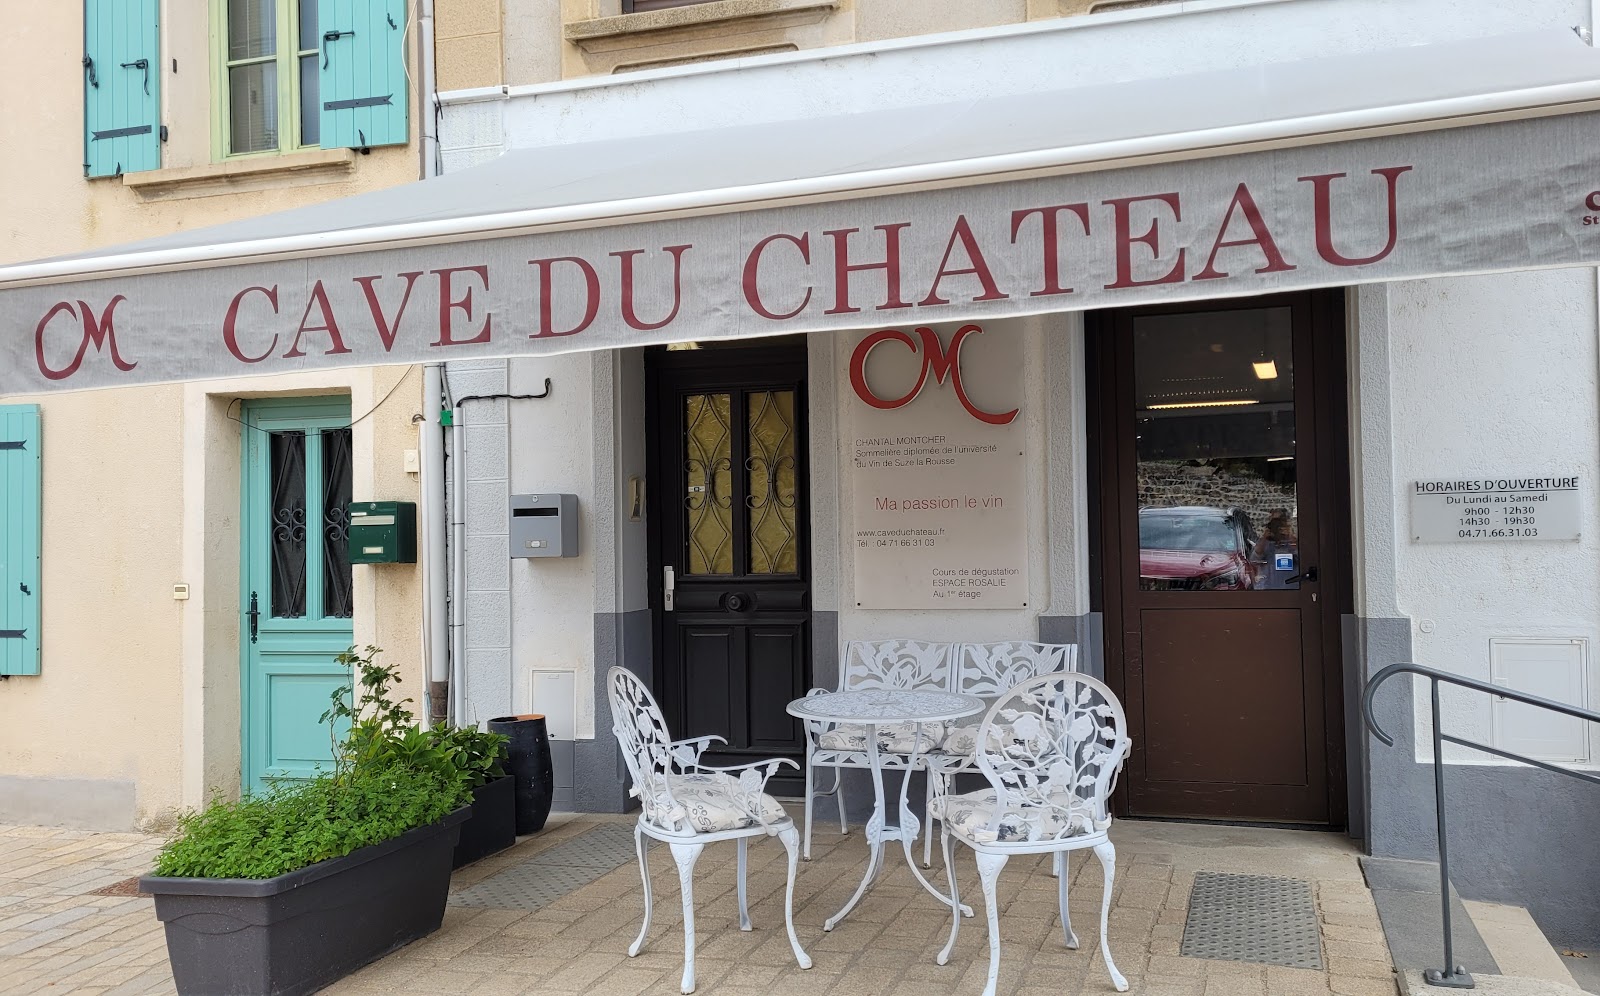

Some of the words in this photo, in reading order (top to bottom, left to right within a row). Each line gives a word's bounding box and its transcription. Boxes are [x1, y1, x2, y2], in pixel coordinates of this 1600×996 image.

[223, 264, 491, 363] CAVE
[529, 244, 693, 339] DU
[742, 165, 1413, 320] CHATEAU
[855, 437, 895, 447] CHANTAL
[896, 435, 946, 445] MONTCHER
[855, 448, 901, 458] Sommelière
[941, 446, 953, 454] de
[954, 444, 997, 454] l'université
[856, 460, 867, 468] du
[868, 459, 881, 468] Vin
[882, 459, 893, 467] de
[894, 458, 915, 467] Suze
[916, 458, 924, 466] la
[925, 457, 956, 466] Rousse
[1416, 480, 1481, 492] HORAIRES
[875, 497, 898, 511] Ma
[902, 495, 959, 514] passion
[964, 494, 977, 509] le
[981, 494, 1003, 508] vin
[1446, 496, 1461, 504] Du
[1463, 494, 1492, 504] Lundi
[1509, 493, 1548, 503] Samedi
[1464, 507, 1490, 516] 9h00
[1502, 506, 1535, 515] 12h30
[1459, 517, 1490, 526] 14h30
[1503, 516, 1536, 525] 19h30
[856, 528, 945, 537] www.caveduchateau.fr
[1458, 528, 1538, 538] 04.71.66.31.03
[876, 539, 887, 547] 04
[889, 539, 898, 547] 71
[900, 539, 911, 547] 66
[912, 539, 923, 547] 31
[924, 538, 935, 547] 03
[932, 568, 957, 576] Cours
[958, 567, 969, 576] de
[971, 567, 1020, 578] dégustation
[932, 578, 967, 587] ESPACE
[968, 578, 1007, 587] ROSALIE
[932, 590, 944, 598] Au
[958, 589, 982, 600] étage
